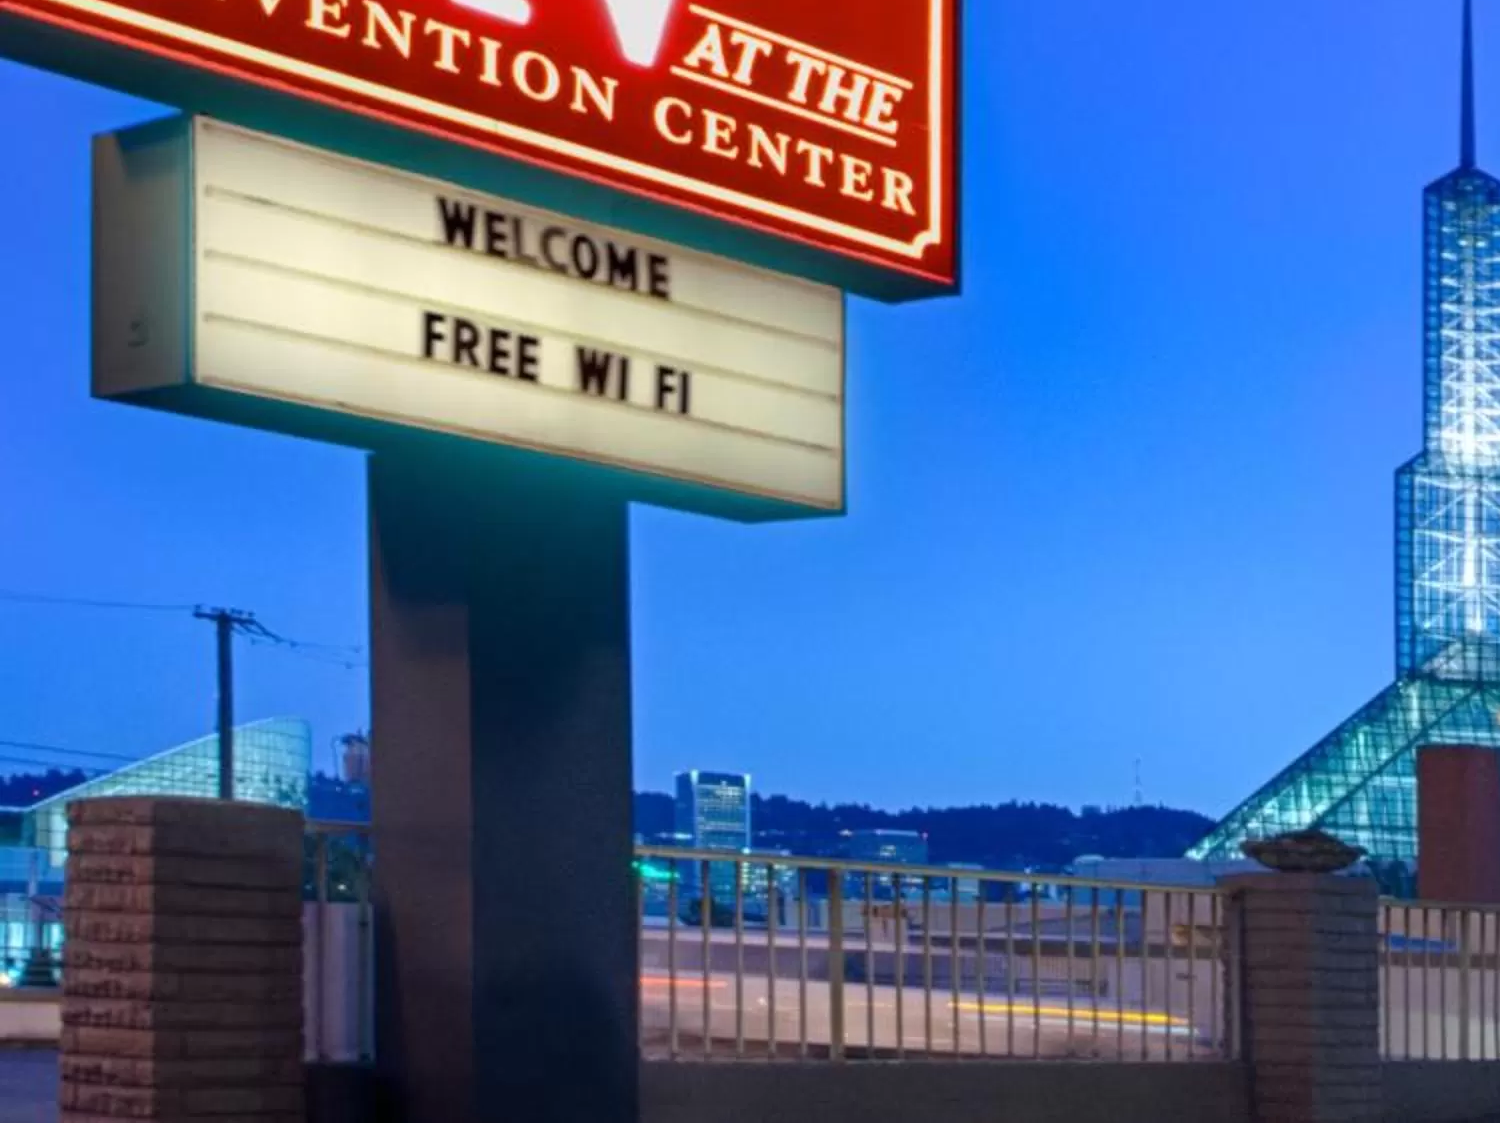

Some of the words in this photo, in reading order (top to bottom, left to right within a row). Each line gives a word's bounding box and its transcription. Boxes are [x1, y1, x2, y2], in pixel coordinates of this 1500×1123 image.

[683, 22, 772, 86] AT
[786, 49, 904, 135] THE
[654, 95, 916, 216] CENTER
[436, 195, 670, 299] WELCOME
[422, 310, 539, 383] FREE
[576, 345, 630, 402] WI
[655, 365, 691, 416] FI
